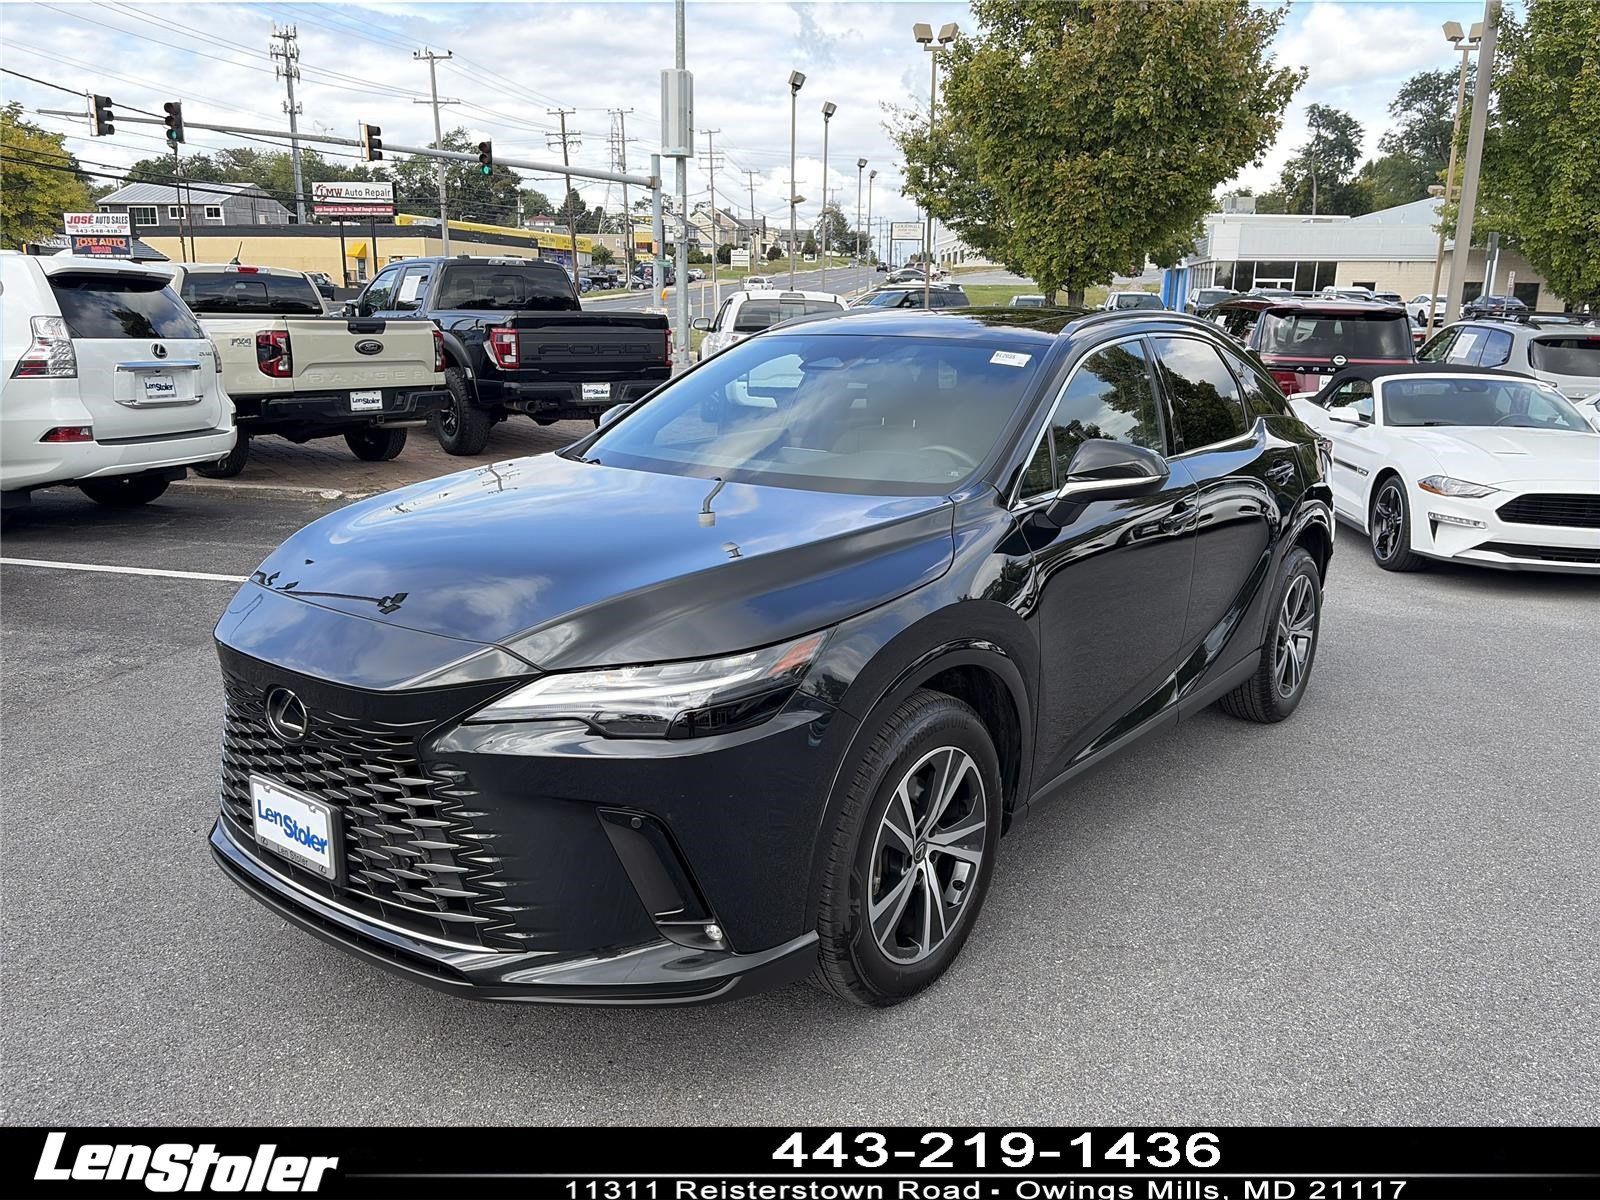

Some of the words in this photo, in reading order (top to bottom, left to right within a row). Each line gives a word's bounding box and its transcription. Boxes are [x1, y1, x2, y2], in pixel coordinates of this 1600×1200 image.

[320, 187, 343, 197] LMW
[344, 188, 364, 197] Auto
[365, 188, 391, 199] Repair
[66, 214, 94, 225] JOSÉ
[95, 215, 110, 225] AUTO
[111, 215, 129, 225] SALES
[99, 237, 127, 247] AUTO
[537, 342, 650, 355] FORD
[308, 369, 425, 384] RANGER
[277, 845, 290, 858] Len
[289, 850, 309, 867] Stoler
